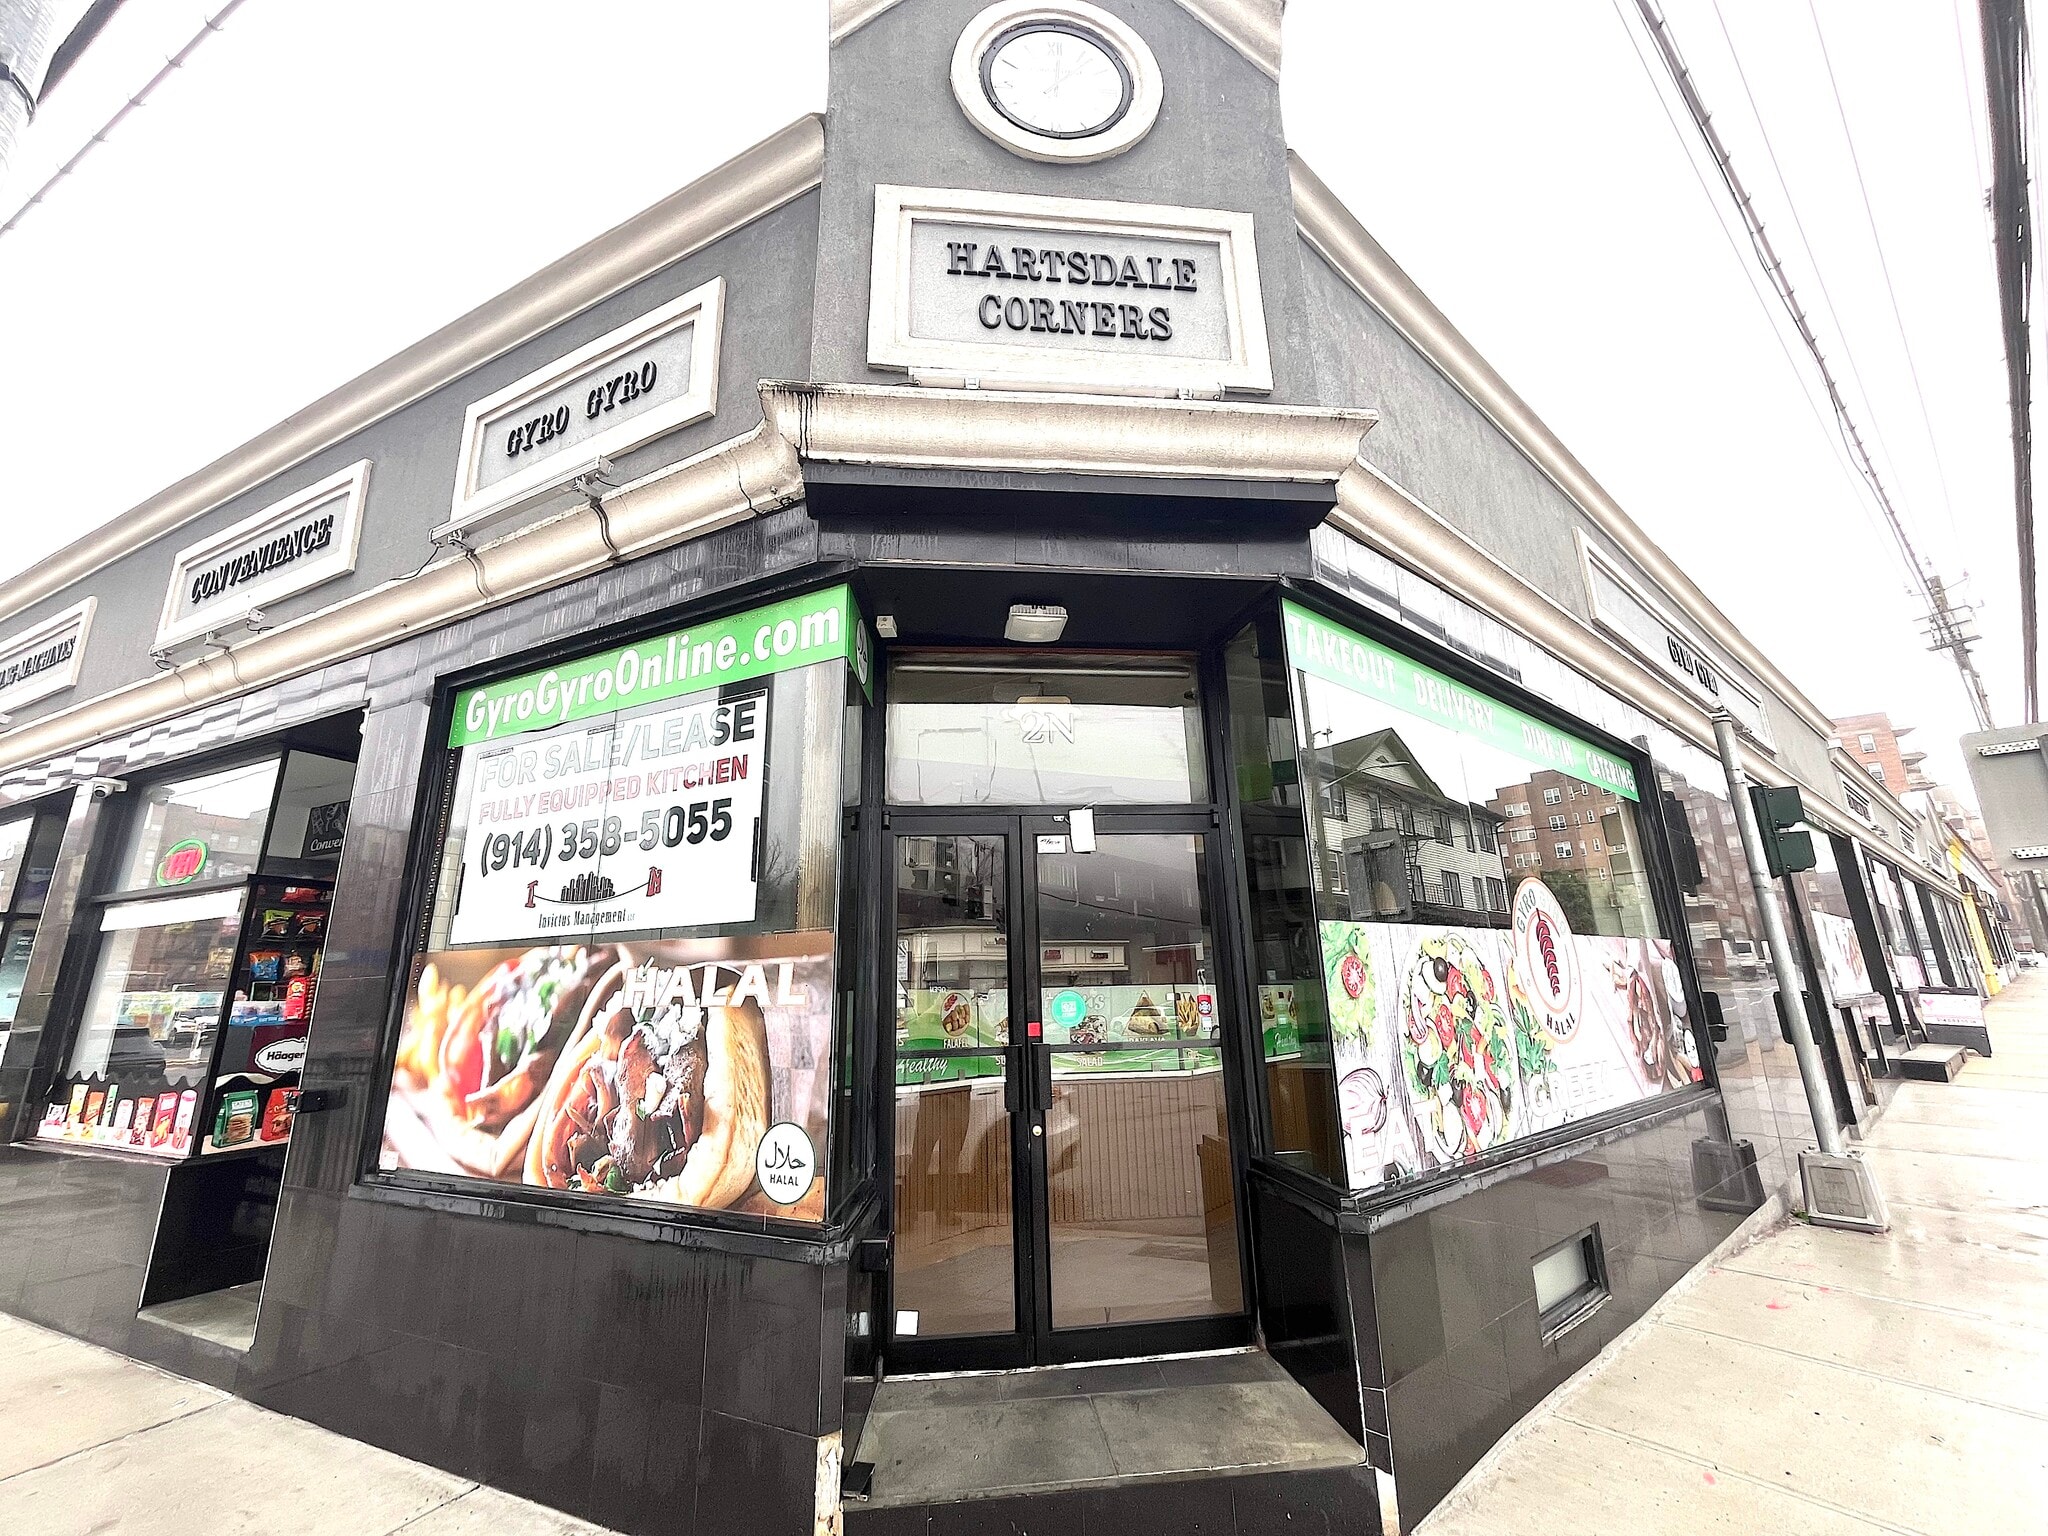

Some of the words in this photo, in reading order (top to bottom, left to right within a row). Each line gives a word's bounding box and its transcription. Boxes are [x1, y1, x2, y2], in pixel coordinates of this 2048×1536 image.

[946, 241, 1198, 293] HARTSDALE
[978, 294, 1173, 342] CORNERS
[506, 404, 570, 457] GYRO
[586, 360, 658, 420] GYRO
[190, 513, 335, 604] CONVENIENCE
[464, 605, 841, 738] GyroGyroOnline.com
[1287, 612, 1397, 695] TAKEOUT
[1413, 671, 1495, 733] DELIVERY
[480, 748, 538, 792] FOR
[542, 700, 757, 780] SALE/LEASE
[1021, 711, 1075, 744] 2N
[478, 793, 536, 825] FULLY
[537, 774, 642, 814] EQUIPPED
[646, 754, 749, 797] KITCHEN
[481, 824, 553, 877] (914)
[558, 797, 734, 862] 358-5055
[538, 912, 571, 929] Invictus
[573, 908, 626, 927] Management
[1516, 888, 1537, 934] GYRO
[624, 960, 807, 1008] HALAL
[1546, 1012, 1576, 1036] HALAL
[769, 1173, 799, 1187] HALAL
